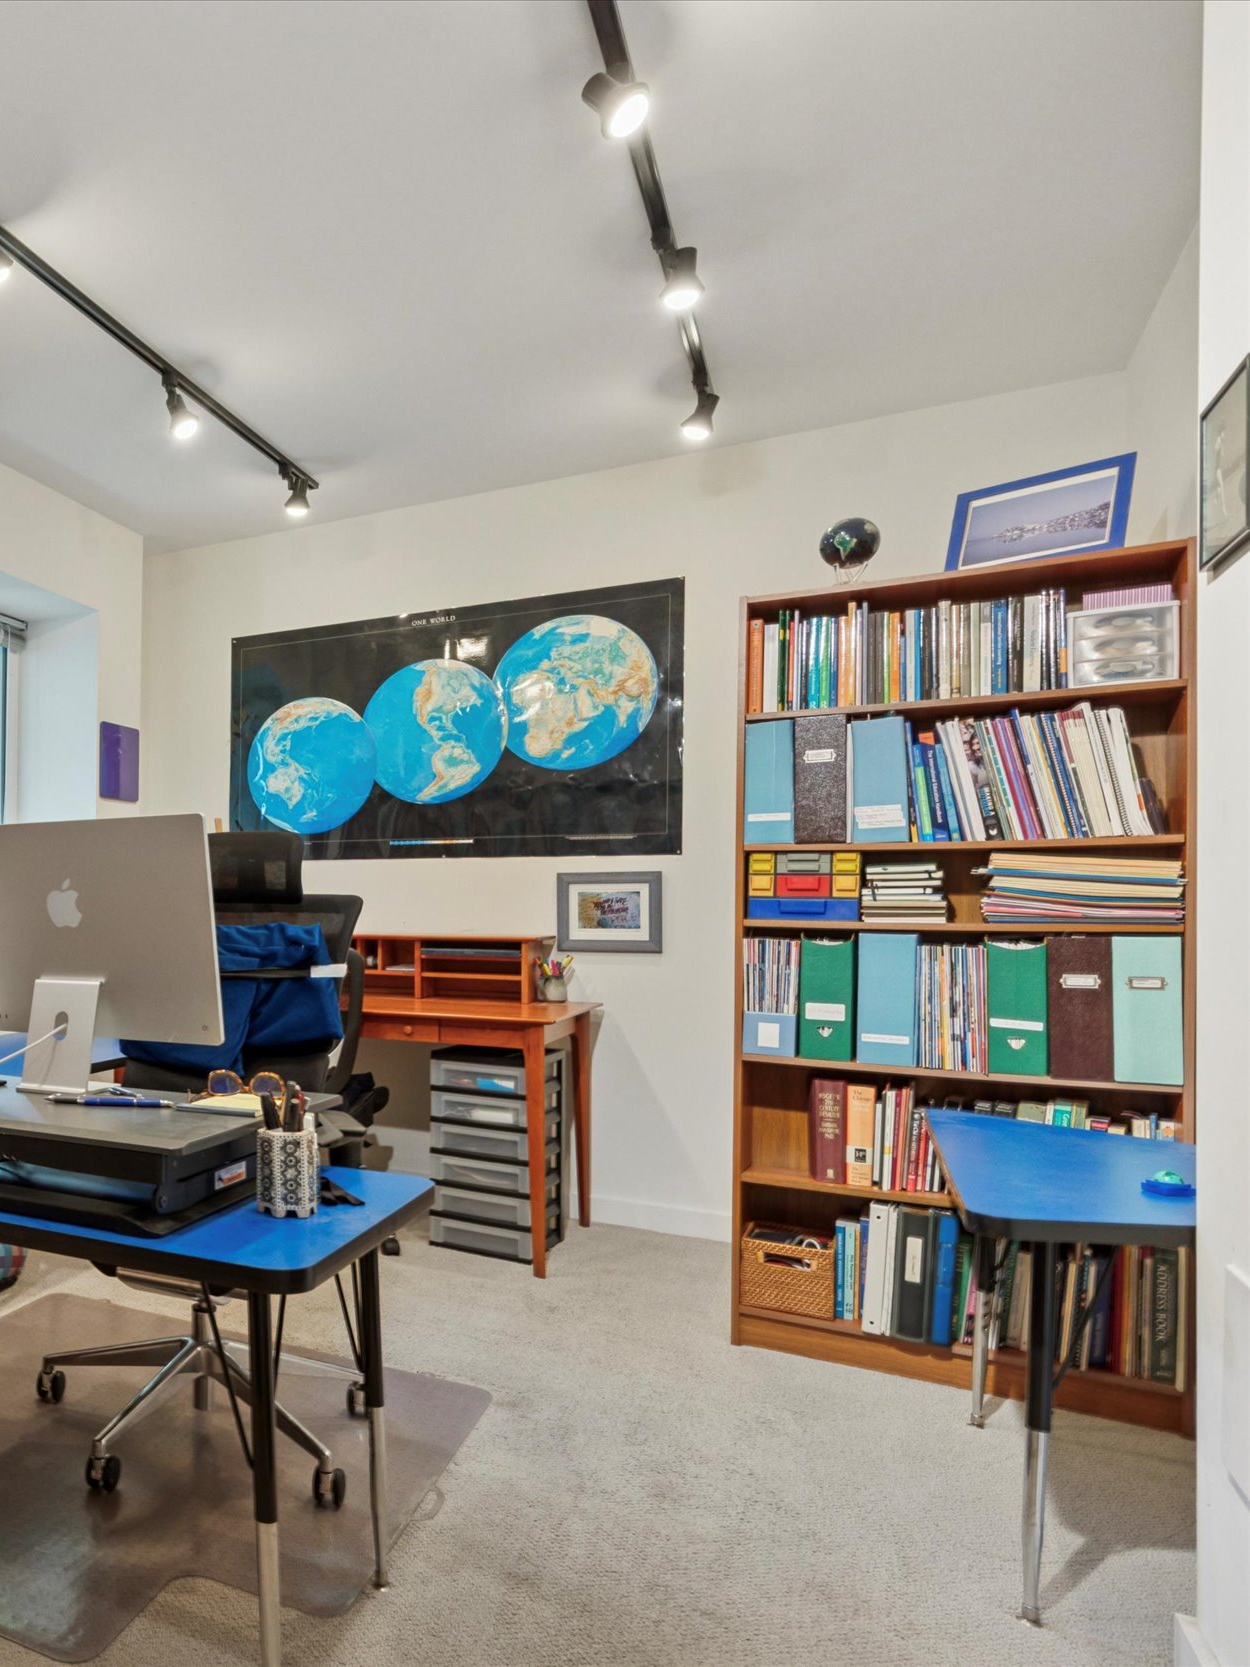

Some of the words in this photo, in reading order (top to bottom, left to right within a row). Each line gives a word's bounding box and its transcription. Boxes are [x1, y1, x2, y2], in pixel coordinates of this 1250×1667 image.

[430, 615, 456, 624] WORLD
[928, 759, 936, 783] International
[1155, 1265, 1168, 1309] ADDRESS
[1155, 1312, 1168, 1342] BOOK
